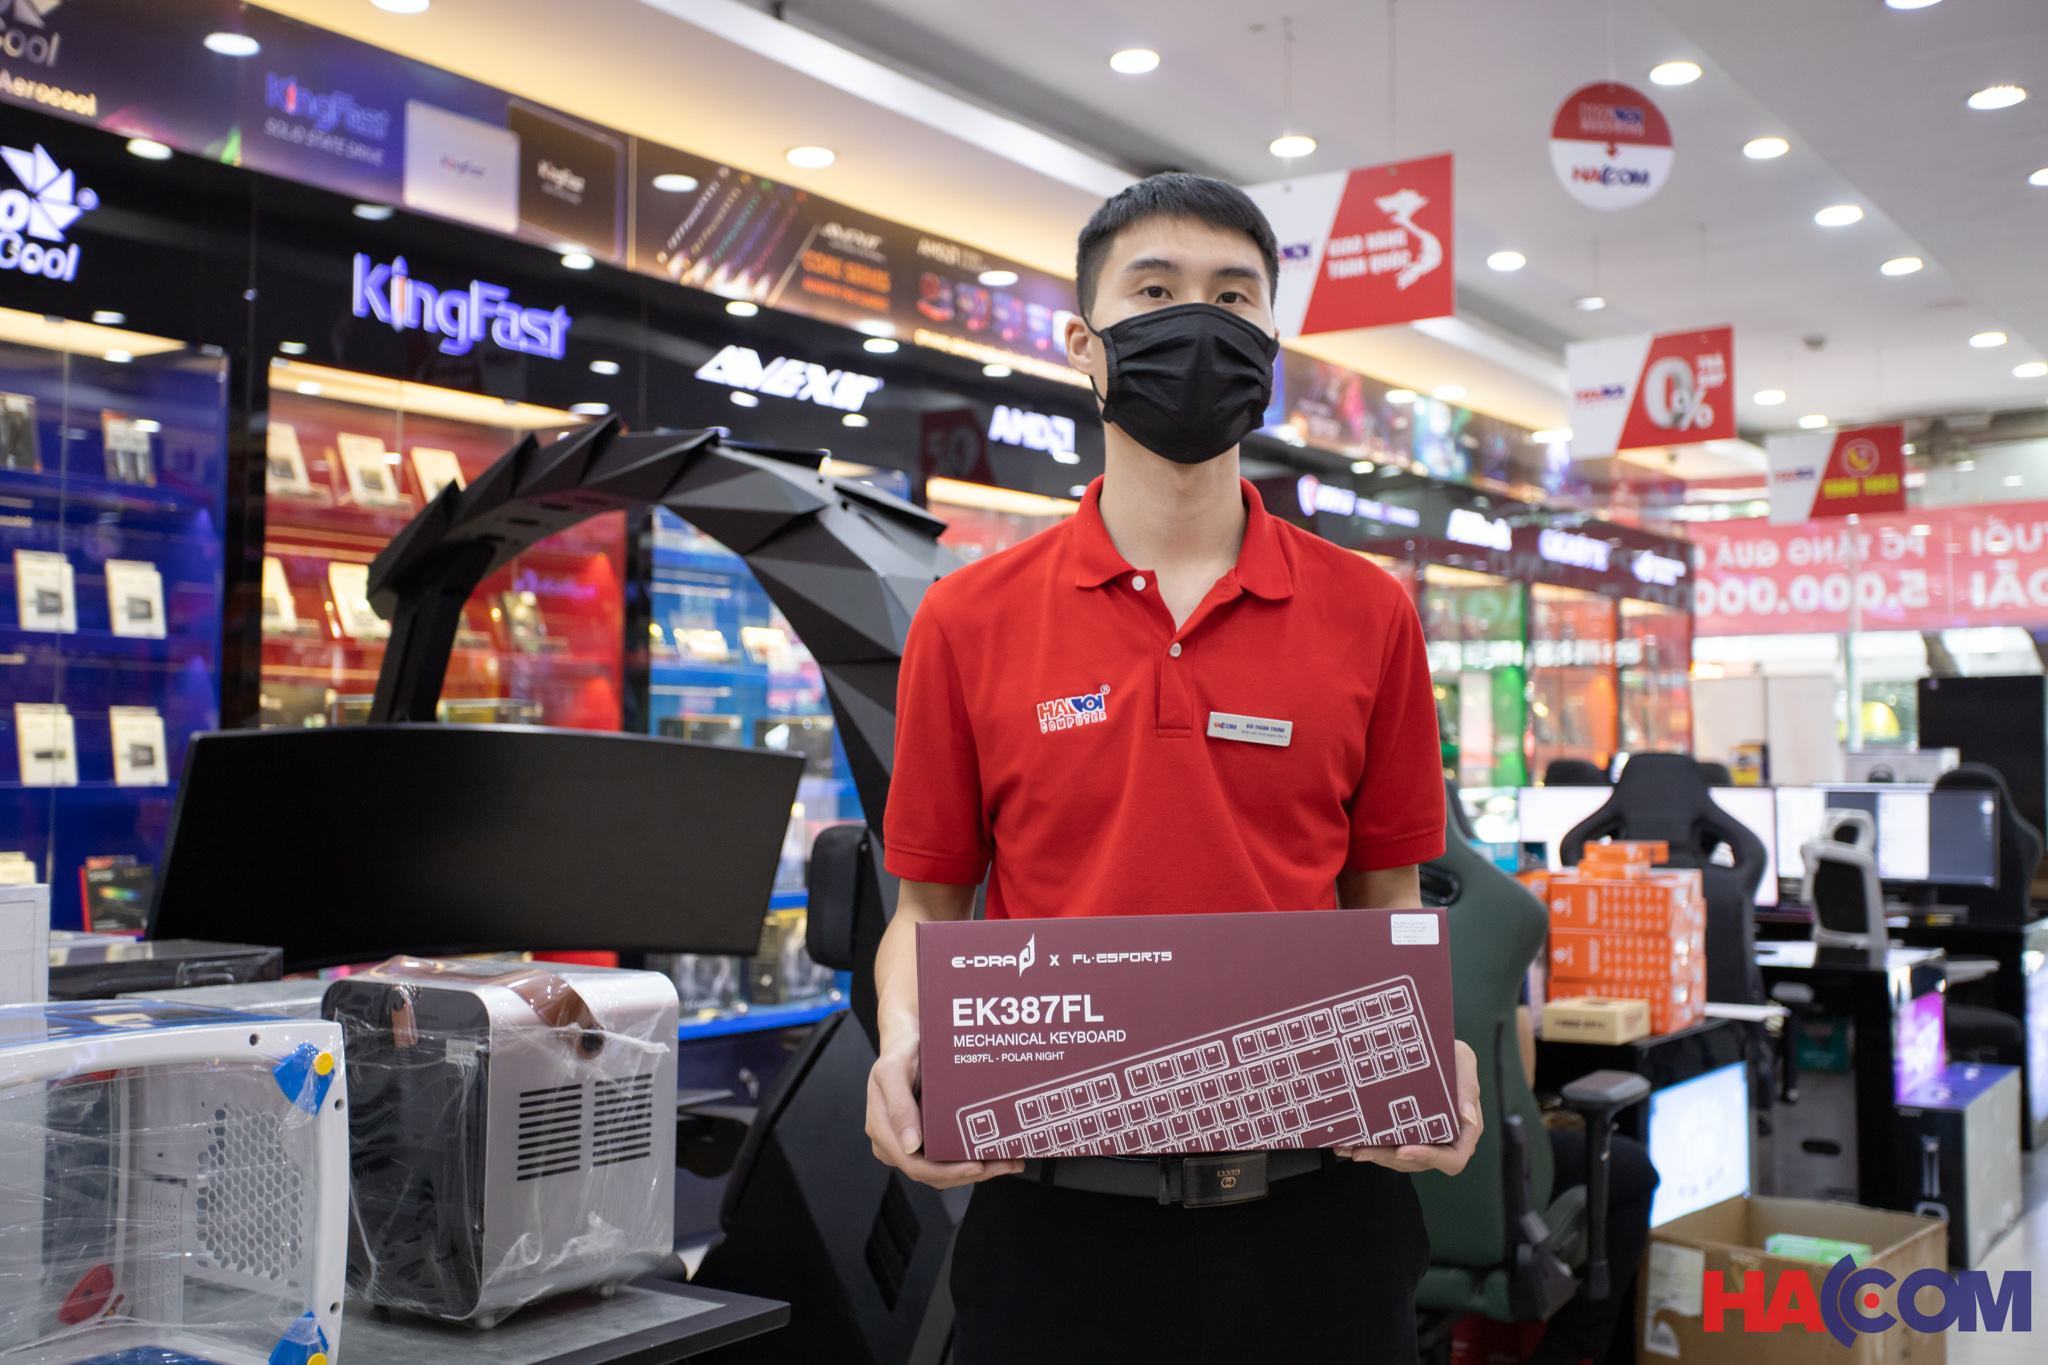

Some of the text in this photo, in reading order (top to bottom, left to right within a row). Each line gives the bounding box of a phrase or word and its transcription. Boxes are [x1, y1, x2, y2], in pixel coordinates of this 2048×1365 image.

[0, 29, 60, 67] ool
[353, 252, 573, 360] KingFast
[952, 994, 1104, 1027] EK387FL
[953, 1030, 1127, 1047] MECHANICAL KEYBOARD
[954, 1054, 994, 1064] EK387FL
[1002, 1053, 1033, 1063] POLAR
[1035, 1051, 1065, 1062] NIGHT
[1217, 1168, 1241, 1178] GUCCI
